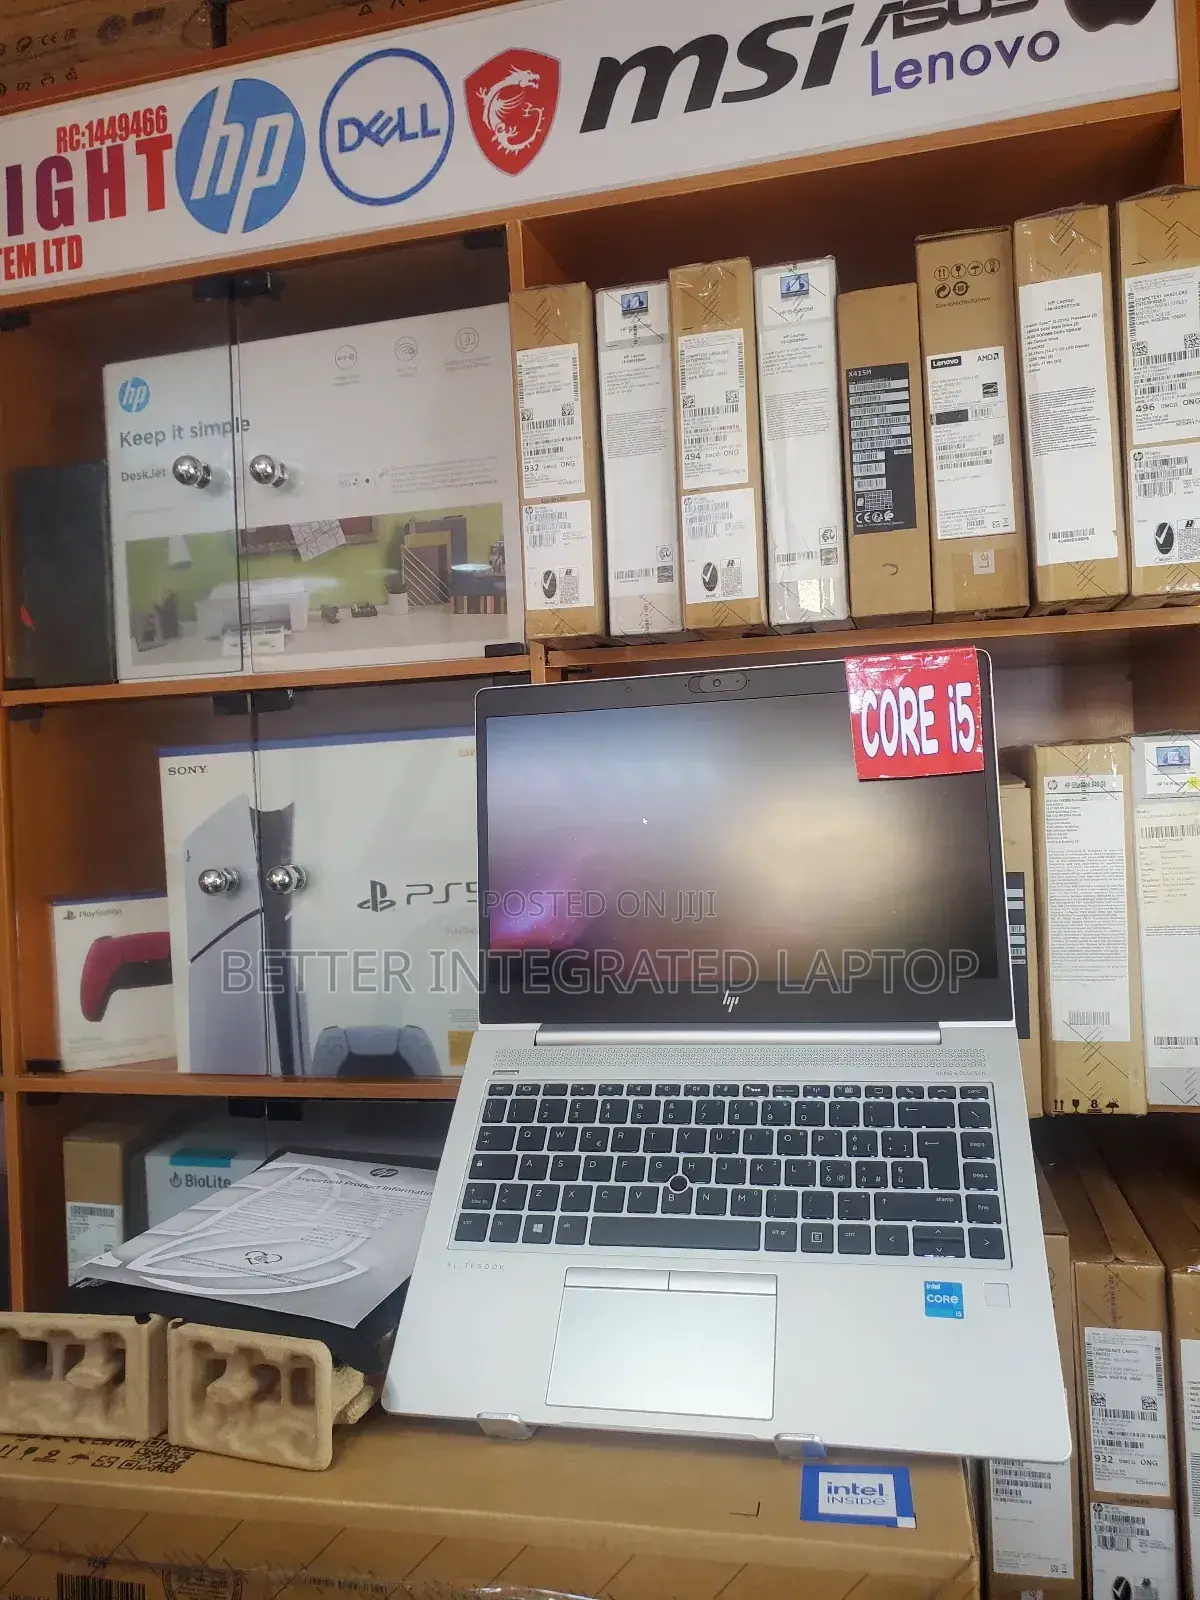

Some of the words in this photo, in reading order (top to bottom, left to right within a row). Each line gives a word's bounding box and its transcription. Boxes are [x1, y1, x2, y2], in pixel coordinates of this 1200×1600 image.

[580, 4, 855, 134] msi
[871, 30, 1060, 96] Lenovo
[56, 105, 168, 154] RC:1449466
[337, 103, 441, 155] DELL
[188, 78, 297, 235] hp
[6, 134, 173, 237] IGHT
[0, 242, 37, 281] EM
[43, 234, 83, 275] LTD
[932, 357, 960, 368] Lenovo
[977, 354, 993, 363] AMD
[119, 377, 150, 413] hp
[1136, 403, 1156, 412] 496
[120, 429, 166, 448] Keep
[172, 424, 184, 440] it
[190, 416, 251, 439] simple
[685, 452, 702, 461] 494
[724, 449, 740, 457] ONG
[121, 468, 168, 482] DeskJet
[524, 464, 540, 473] 932
[861, 684, 939, 758] CORE
[948, 682, 976, 754] i5
[168, 765, 208, 776] SONY
[79, 908, 123, 919] PlayStation
[558, 1160, 564, 1168] S
[688, 1162, 695, 1170] H
[185, 1174, 231, 1189] BioLite
[294, 1176, 343, 1185] Important
[344, 1180, 382, 1190] Product
[382, 1186, 433, 1196] Informatio
[1094, 1455, 1113, 1464] 932
[1140, 1459, 1159, 1467] ONG
[826, 1482, 888, 1497] intel
